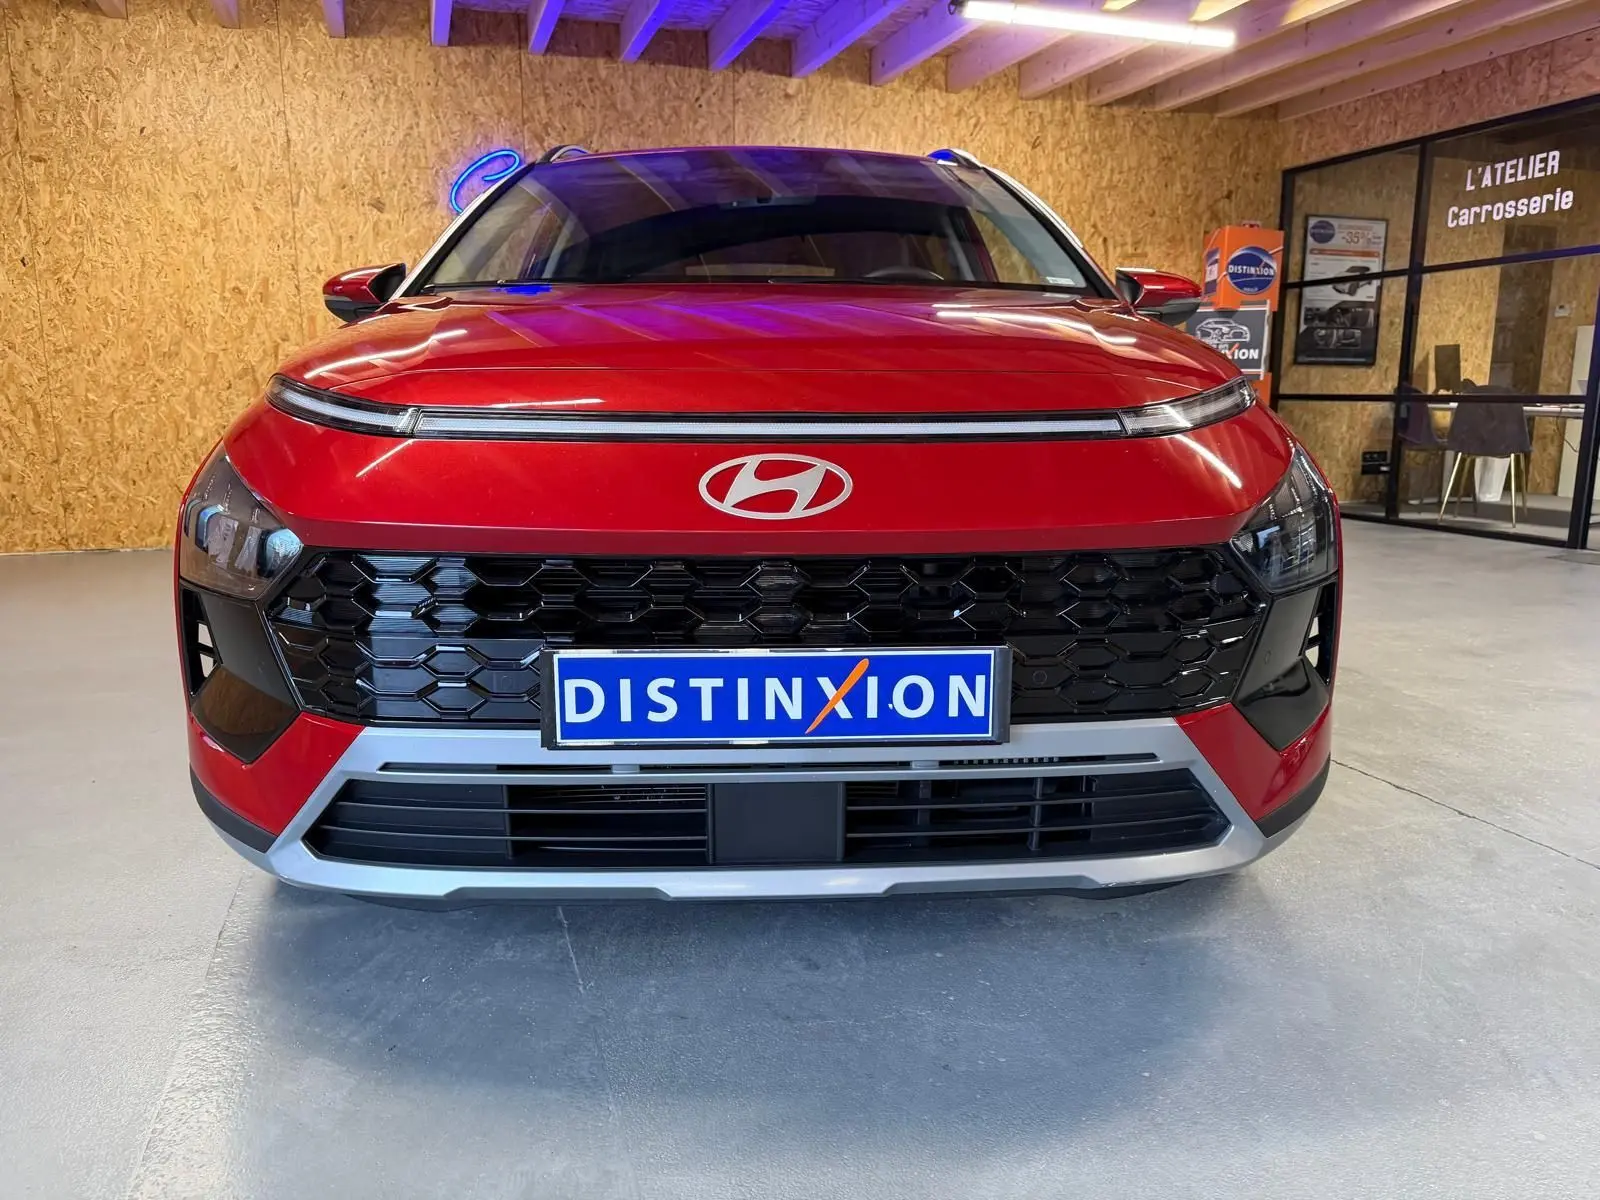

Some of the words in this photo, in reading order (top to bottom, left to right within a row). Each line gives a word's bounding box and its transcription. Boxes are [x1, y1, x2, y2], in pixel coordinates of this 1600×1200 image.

[1465, 150, 1560, 191] L'ATELIER
[1447, 187, 1574, 228] Carrosserie
[564, 658, 986, 734] DISTINXION
